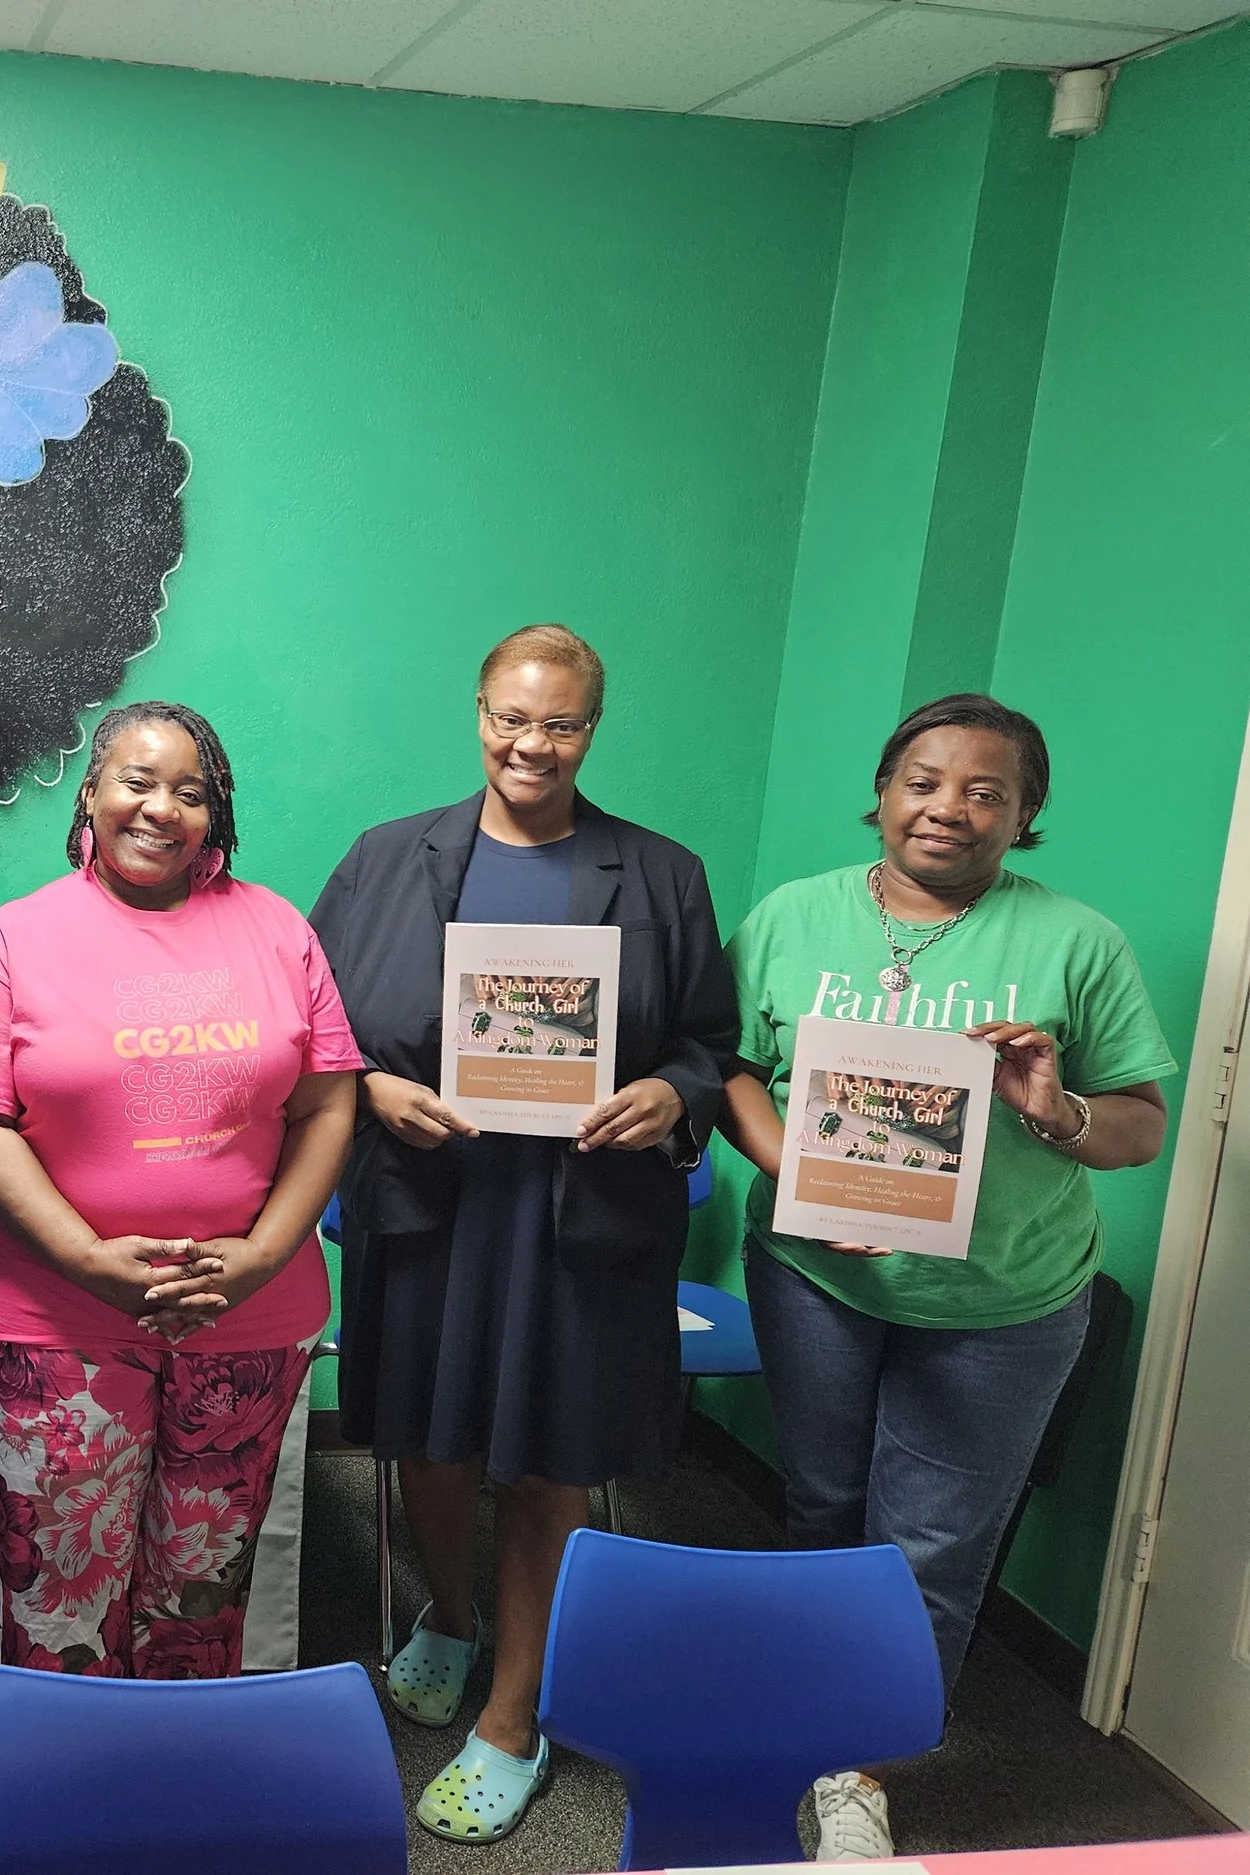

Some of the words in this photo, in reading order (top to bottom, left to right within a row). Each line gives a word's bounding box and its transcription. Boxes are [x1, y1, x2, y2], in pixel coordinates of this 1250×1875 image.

[484, 958, 550, 967] AWAKENING
[553, 960, 574, 968] HER
[113, 967, 235, 999] CG2KW
[478, 978, 505, 991] The
[505, 979, 567, 996] Journey
[570, 980, 589, 995] of
[116, 993, 244, 1023] CG2KW
[479, 1000, 486, 1009] a
[495, 995, 544, 1013] Church
[553, 998, 578, 1014] Girl
[518, 1016, 534, 1026] to
[113, 1020, 259, 1059] CG2KW
[454, 1031, 464, 1042] A
[468, 1031, 536, 1047] Kingdom
[539, 1035, 600, 1049] Woman
[121, 1055, 261, 1094] CG2KW
[838, 1056, 914, 1072] AWAKENING
[917, 1065, 942, 1075] HER
[830, 1076, 859, 1092] The
[863, 1081, 932, 1103] Journey
[935, 1090, 958, 1106] of
[124, 1085, 262, 1126] CG2KW
[830, 1099, 837, 1110] a
[849, 1098, 903, 1120] Church
[914, 1107, 943, 1125] Girl
[185, 1127, 236, 1145] CHURCH
[873, 1121, 890, 1134] to
[798, 1129, 809, 1143] A
[813, 1132, 890, 1155] Kingdom
[896, 1142, 965, 1165] Woman
[900, 1190, 910, 1198] the
